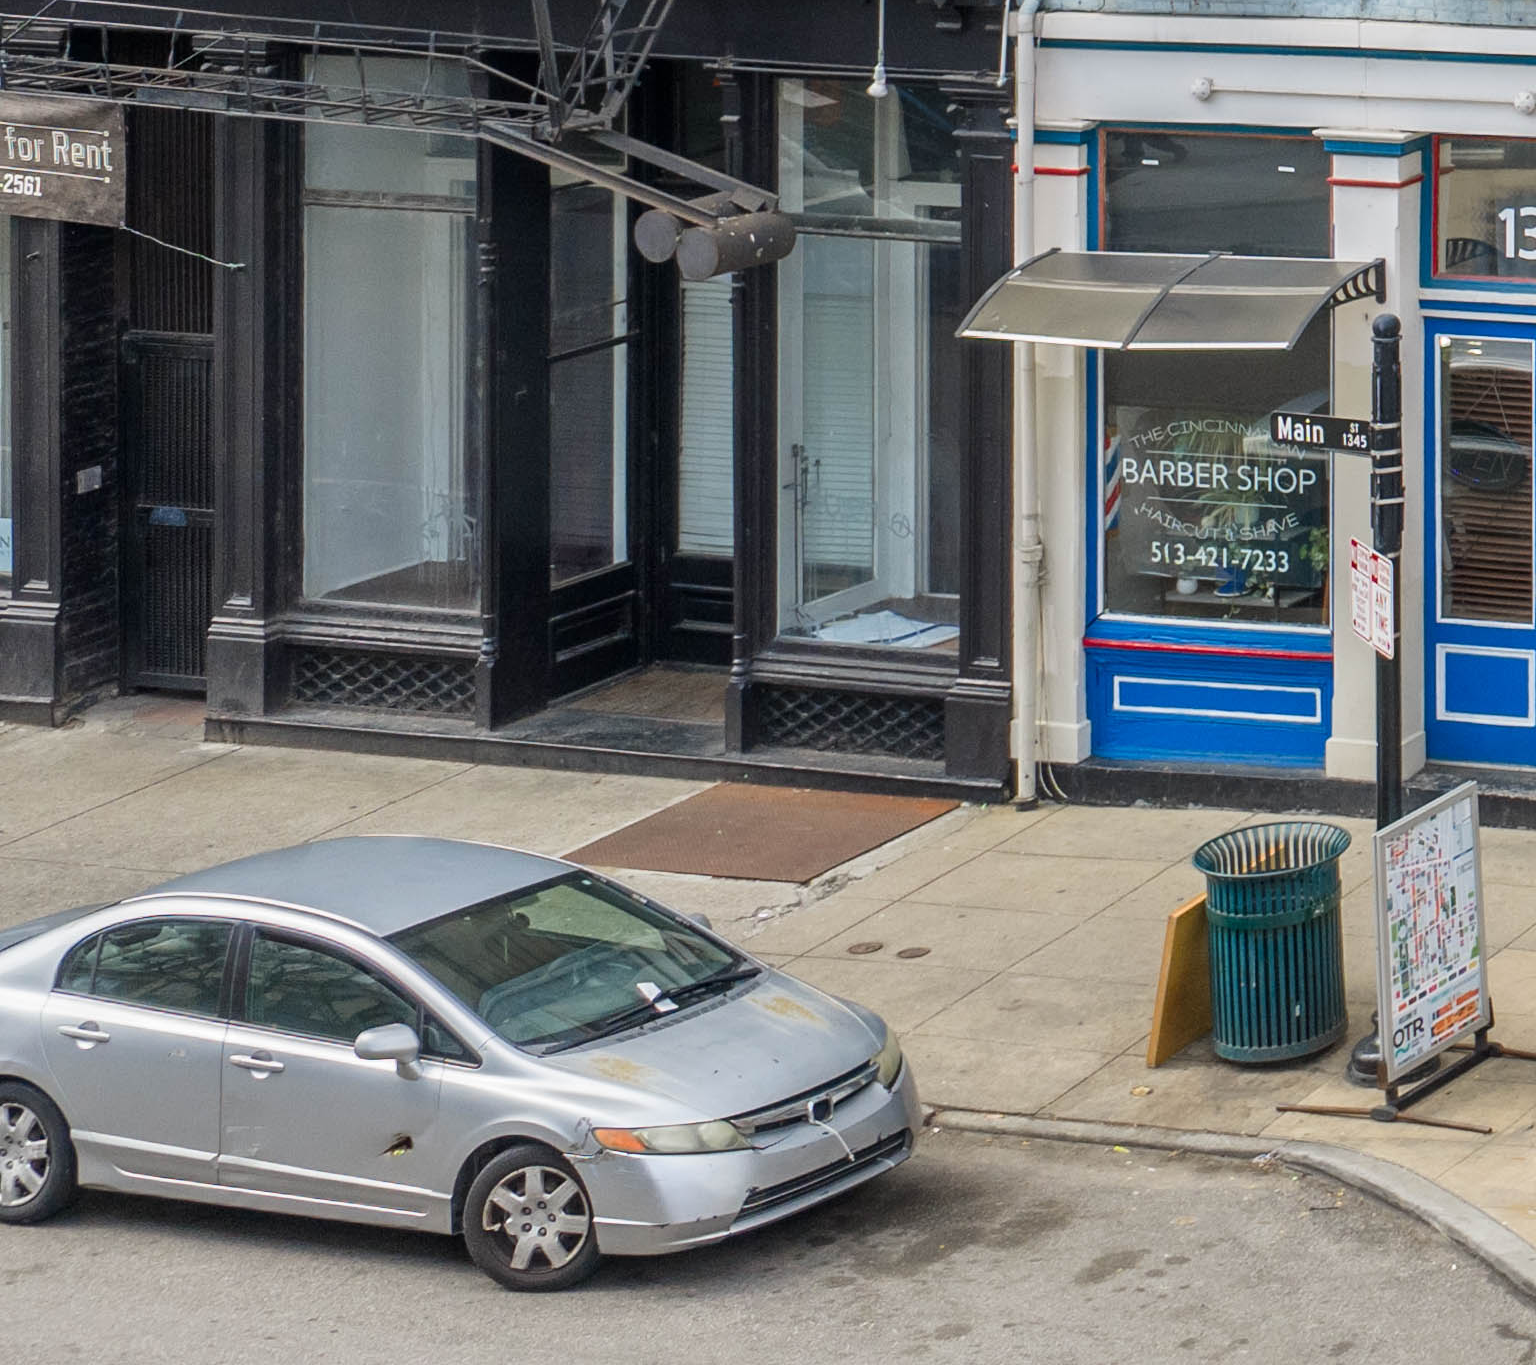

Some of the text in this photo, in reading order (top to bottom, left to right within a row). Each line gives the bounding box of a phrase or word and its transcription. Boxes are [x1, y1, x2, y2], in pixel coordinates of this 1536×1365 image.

[4, 126, 113, 172] for Rent
[1129, 426, 1165, 449] THE
[1277, 415, 1359, 444] Main ST
[1342, 432, 1368, 448] 1345
[1122, 457, 1317, 495] BARBER SHOP
[1138, 502, 1220, 541] HAIRCUT
[1239, 512, 1300, 542] SHAVE
[1151, 540, 1290, 573] 513-421-7233
[1393, 1017, 1425, 1048] OTR
